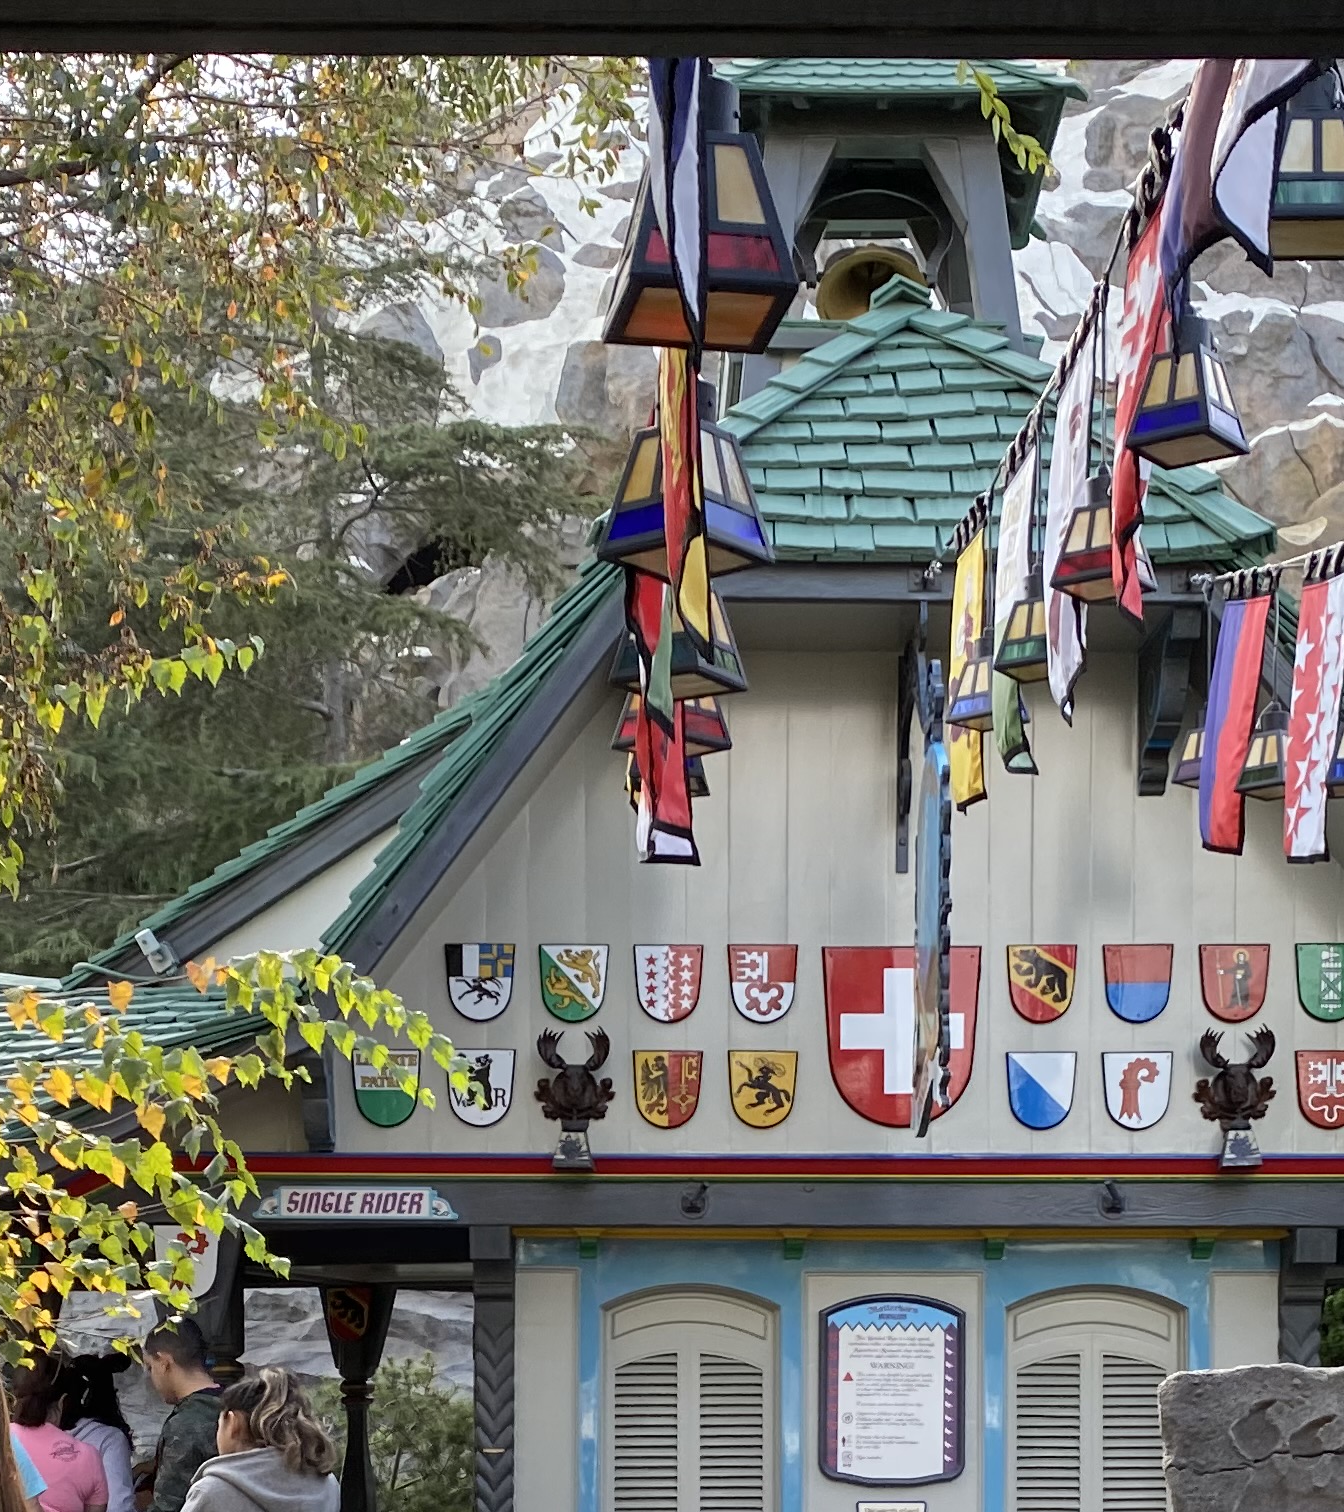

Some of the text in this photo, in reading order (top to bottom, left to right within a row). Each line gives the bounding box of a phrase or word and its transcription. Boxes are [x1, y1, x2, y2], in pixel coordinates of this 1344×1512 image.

[493, 1087, 506, 1107] R
[286, 1191, 424, 1214] SINGLE RIDER
